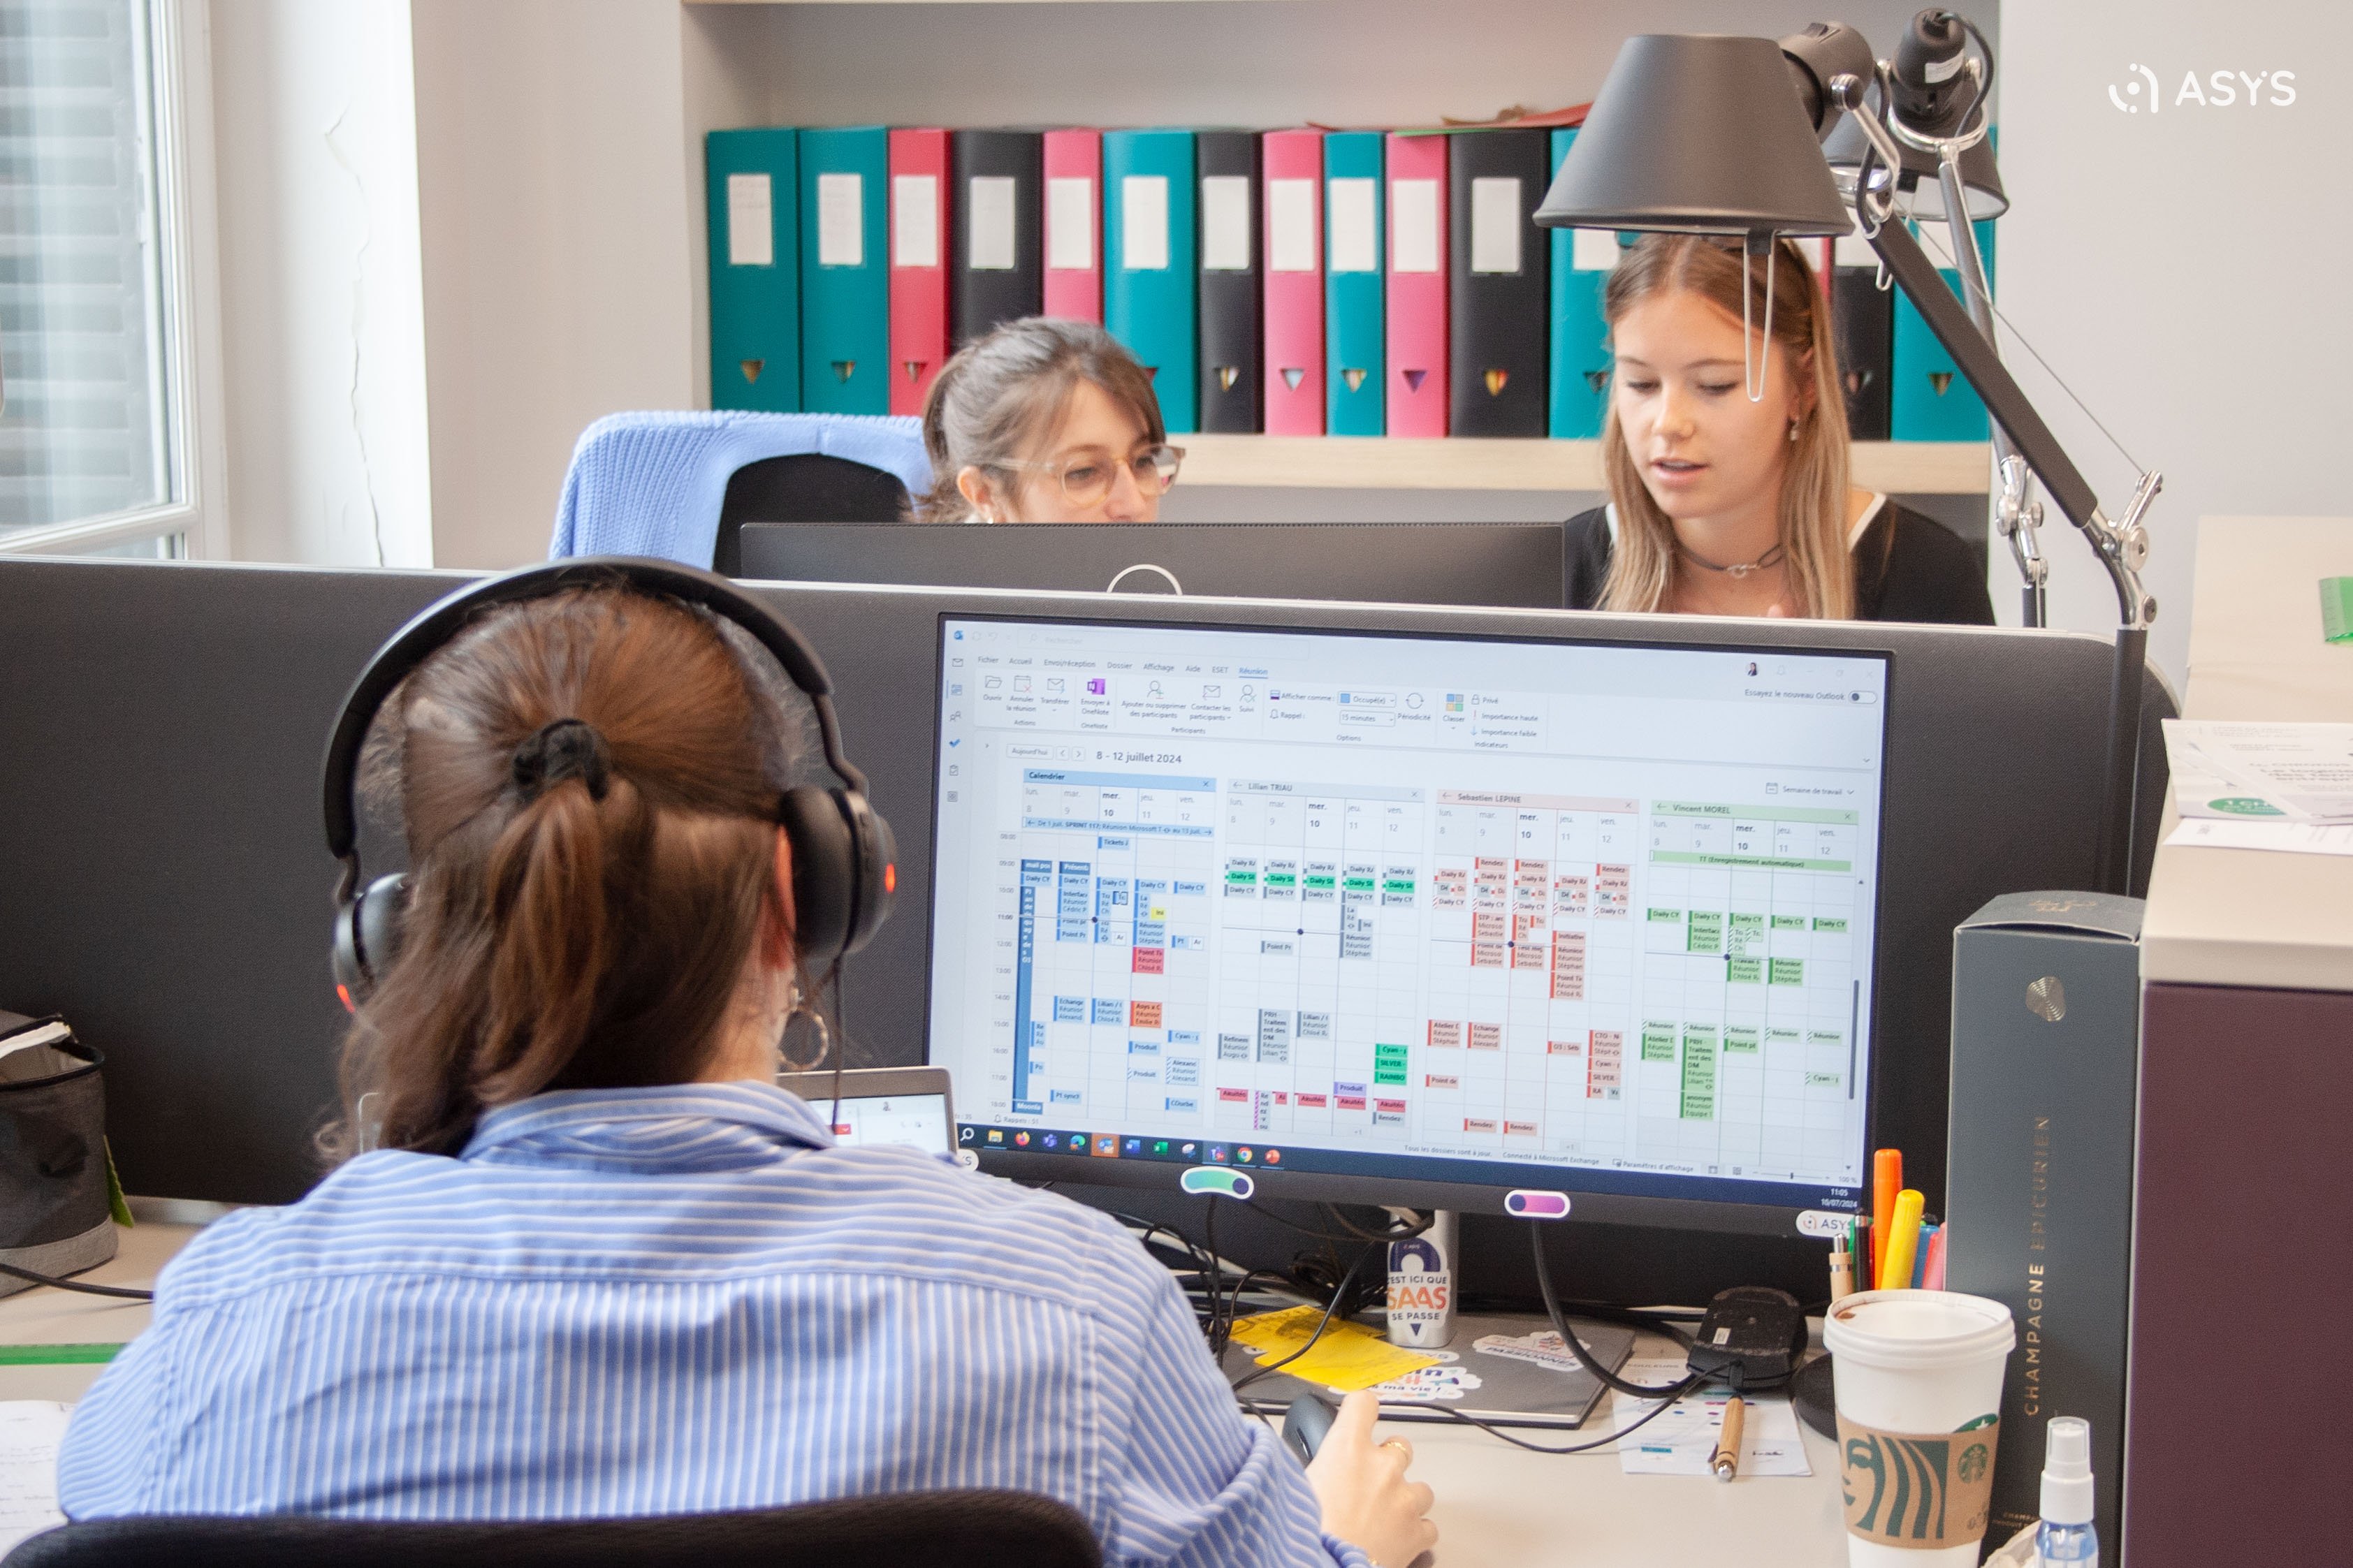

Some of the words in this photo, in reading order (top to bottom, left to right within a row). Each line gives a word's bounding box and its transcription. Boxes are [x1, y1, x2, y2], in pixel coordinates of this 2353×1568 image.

[977, 656, 999, 665] Fichier
[1009, 657, 1032, 666] Accueil
[1044, 659, 1095, 669] Envoi/réception
[1107, 661, 1132, 670] Dossier
[1144, 663, 1174, 673] Affichage
[1239, 667, 1268, 675] Réunion
[1281, 692, 1306, 701] Afficher
[1744, 689, 1772, 699] Essayez
[1010, 695, 1034, 703] Annuler
[1041, 697, 1070, 705] Transférer
[1081, 698, 1104, 708] Envoyer
[1353, 695, 1386, 705] Occupé(e)
[1014, 705, 1036, 713] réunion
[1121, 700, 1144, 710] Ajouter
[1156, 703, 1186, 711] supprimer
[1081, 708, 1109, 716] OneNote
[1142, 711, 1177, 720] participants
[1281, 712, 1302, 720] Rappel
[1481, 712, 1517, 721] Importance
[1190, 713, 1226, 721] participants
[1398, 713, 1431, 721] Périodicité
[1443, 715, 1465, 723] Classer
[1014, 719, 1036, 727] Actions
[1172, 726, 1205, 735] Participants
[1481, 728, 1517, 738] Importance
[1336, 735, 1361, 743] Options
[1475, 741, 1508, 749] Indicateurs
[1113, 752, 1123, 761] 12
[1125, 752, 1153, 763] juillet
[1157, 754, 1181, 763] 2024
[1029, 772, 1065, 781] Calendrier
[1026, 788, 1038, 796] lun.
[1458, 793, 1493, 802] Sebastien
[1026, 805, 1032, 813] 8
[1142, 810, 1151, 819] 11
[1695, 821, 1712, 830] mar.
[1736, 824, 1755, 833] mer.
[1179, 884, 1195, 892] Daily
[1438, 898, 1455, 907] Daily
[1654, 910, 1669, 918] Daily
[1819, 920, 1835, 928] Daily
[1570, 1157, 1599, 1165] Exchange
[1831, 1188, 1848, 1196] 11:05
[1821, 1199, 1858, 1208] 10/07/2024
[1387, 1286, 1447, 1310] SAAS
[2025, 1263, 2045, 1416] CHAMPAGNE
